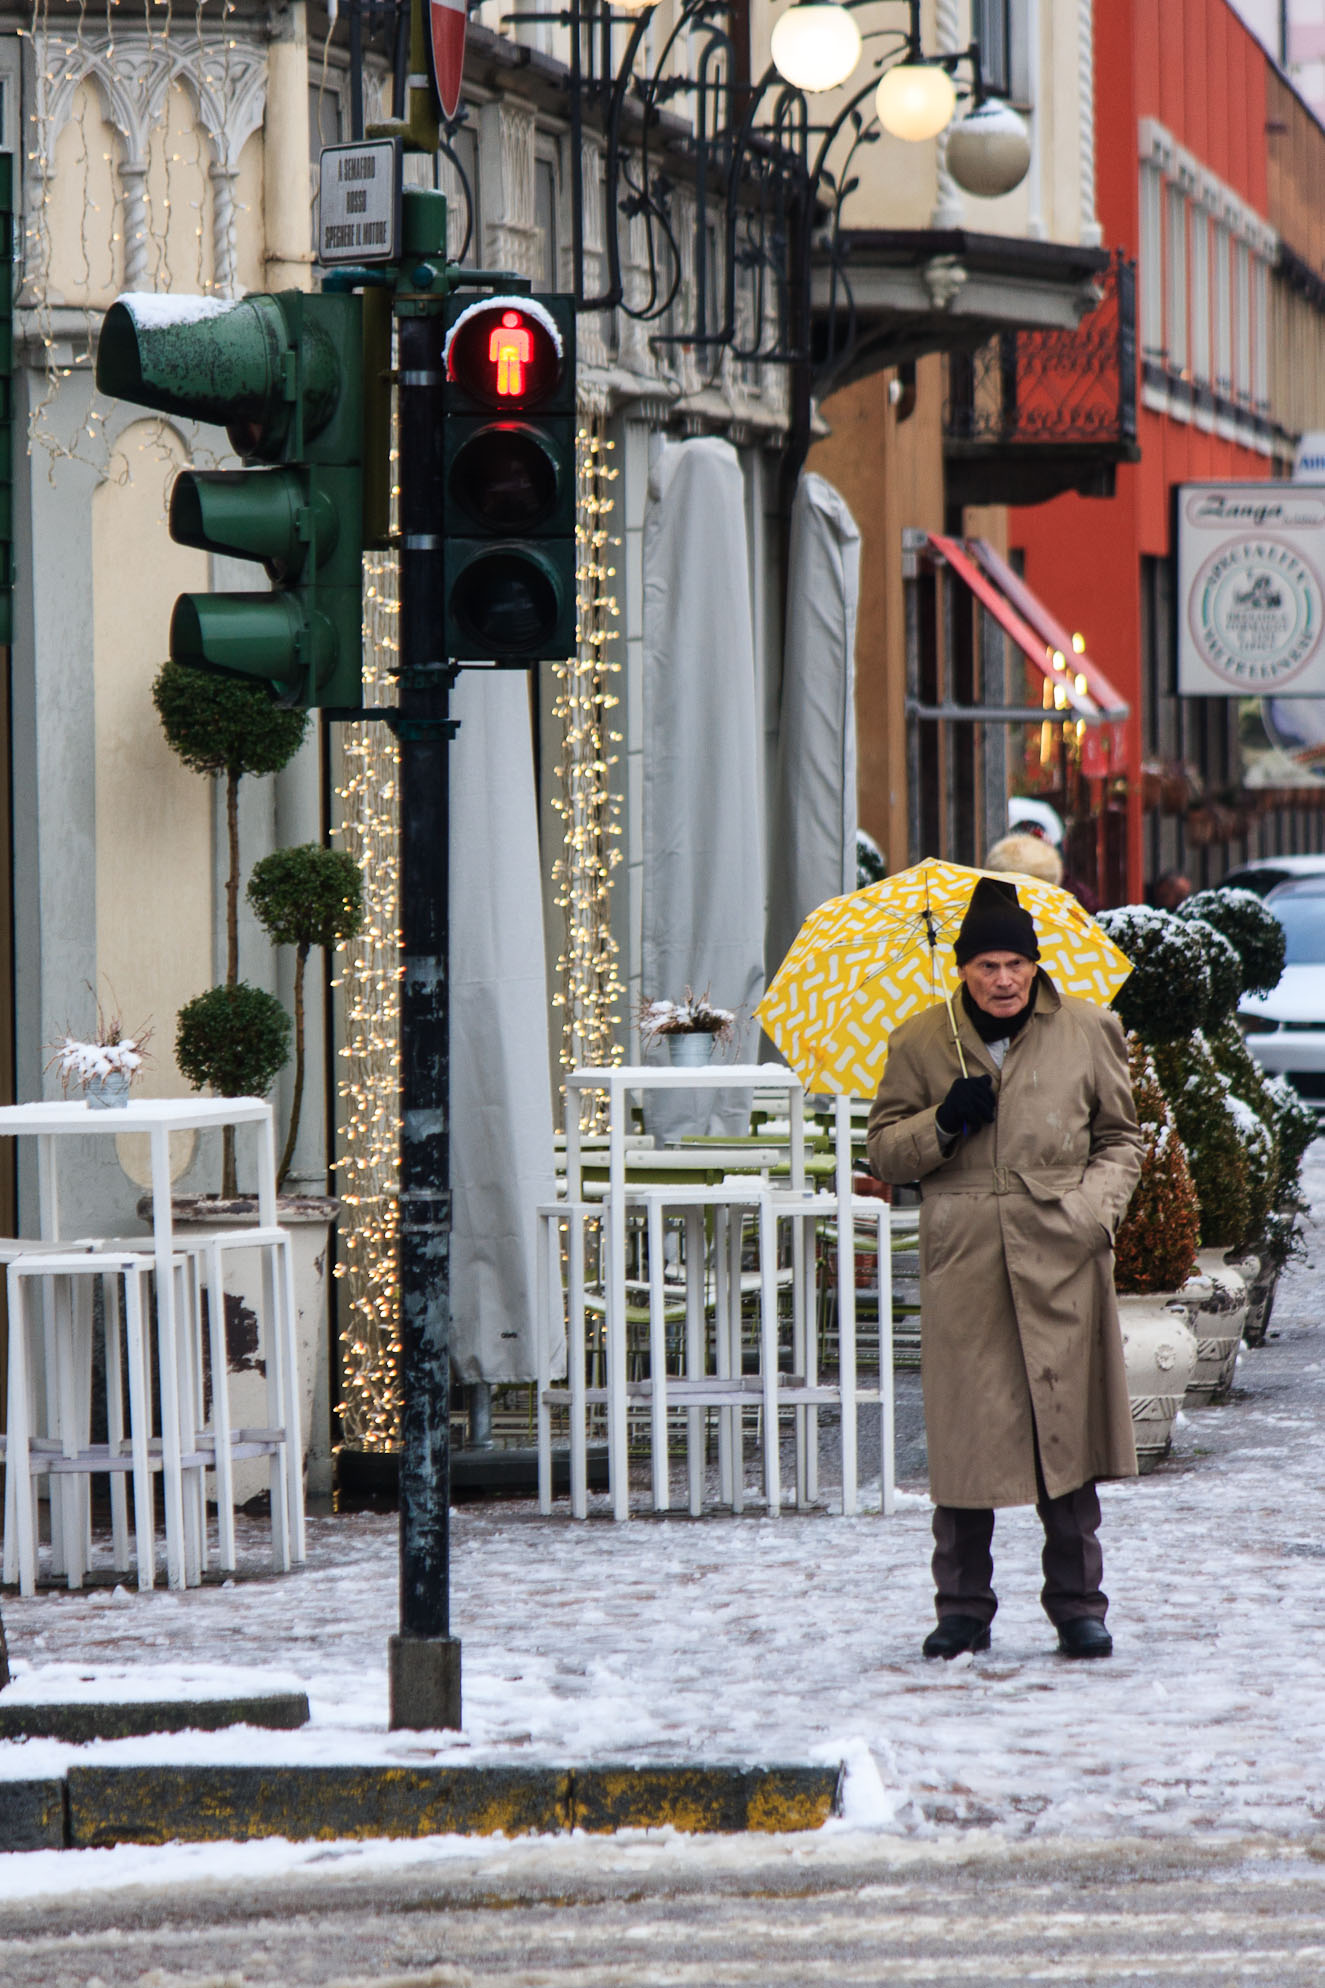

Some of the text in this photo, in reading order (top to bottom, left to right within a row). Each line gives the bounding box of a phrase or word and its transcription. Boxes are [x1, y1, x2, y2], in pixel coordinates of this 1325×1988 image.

[338, 156, 375, 182] A SEMAFORO
[346, 190, 367, 214] ROSSO
[325, 221, 387, 249] SPEGNERE IL MOTORE
